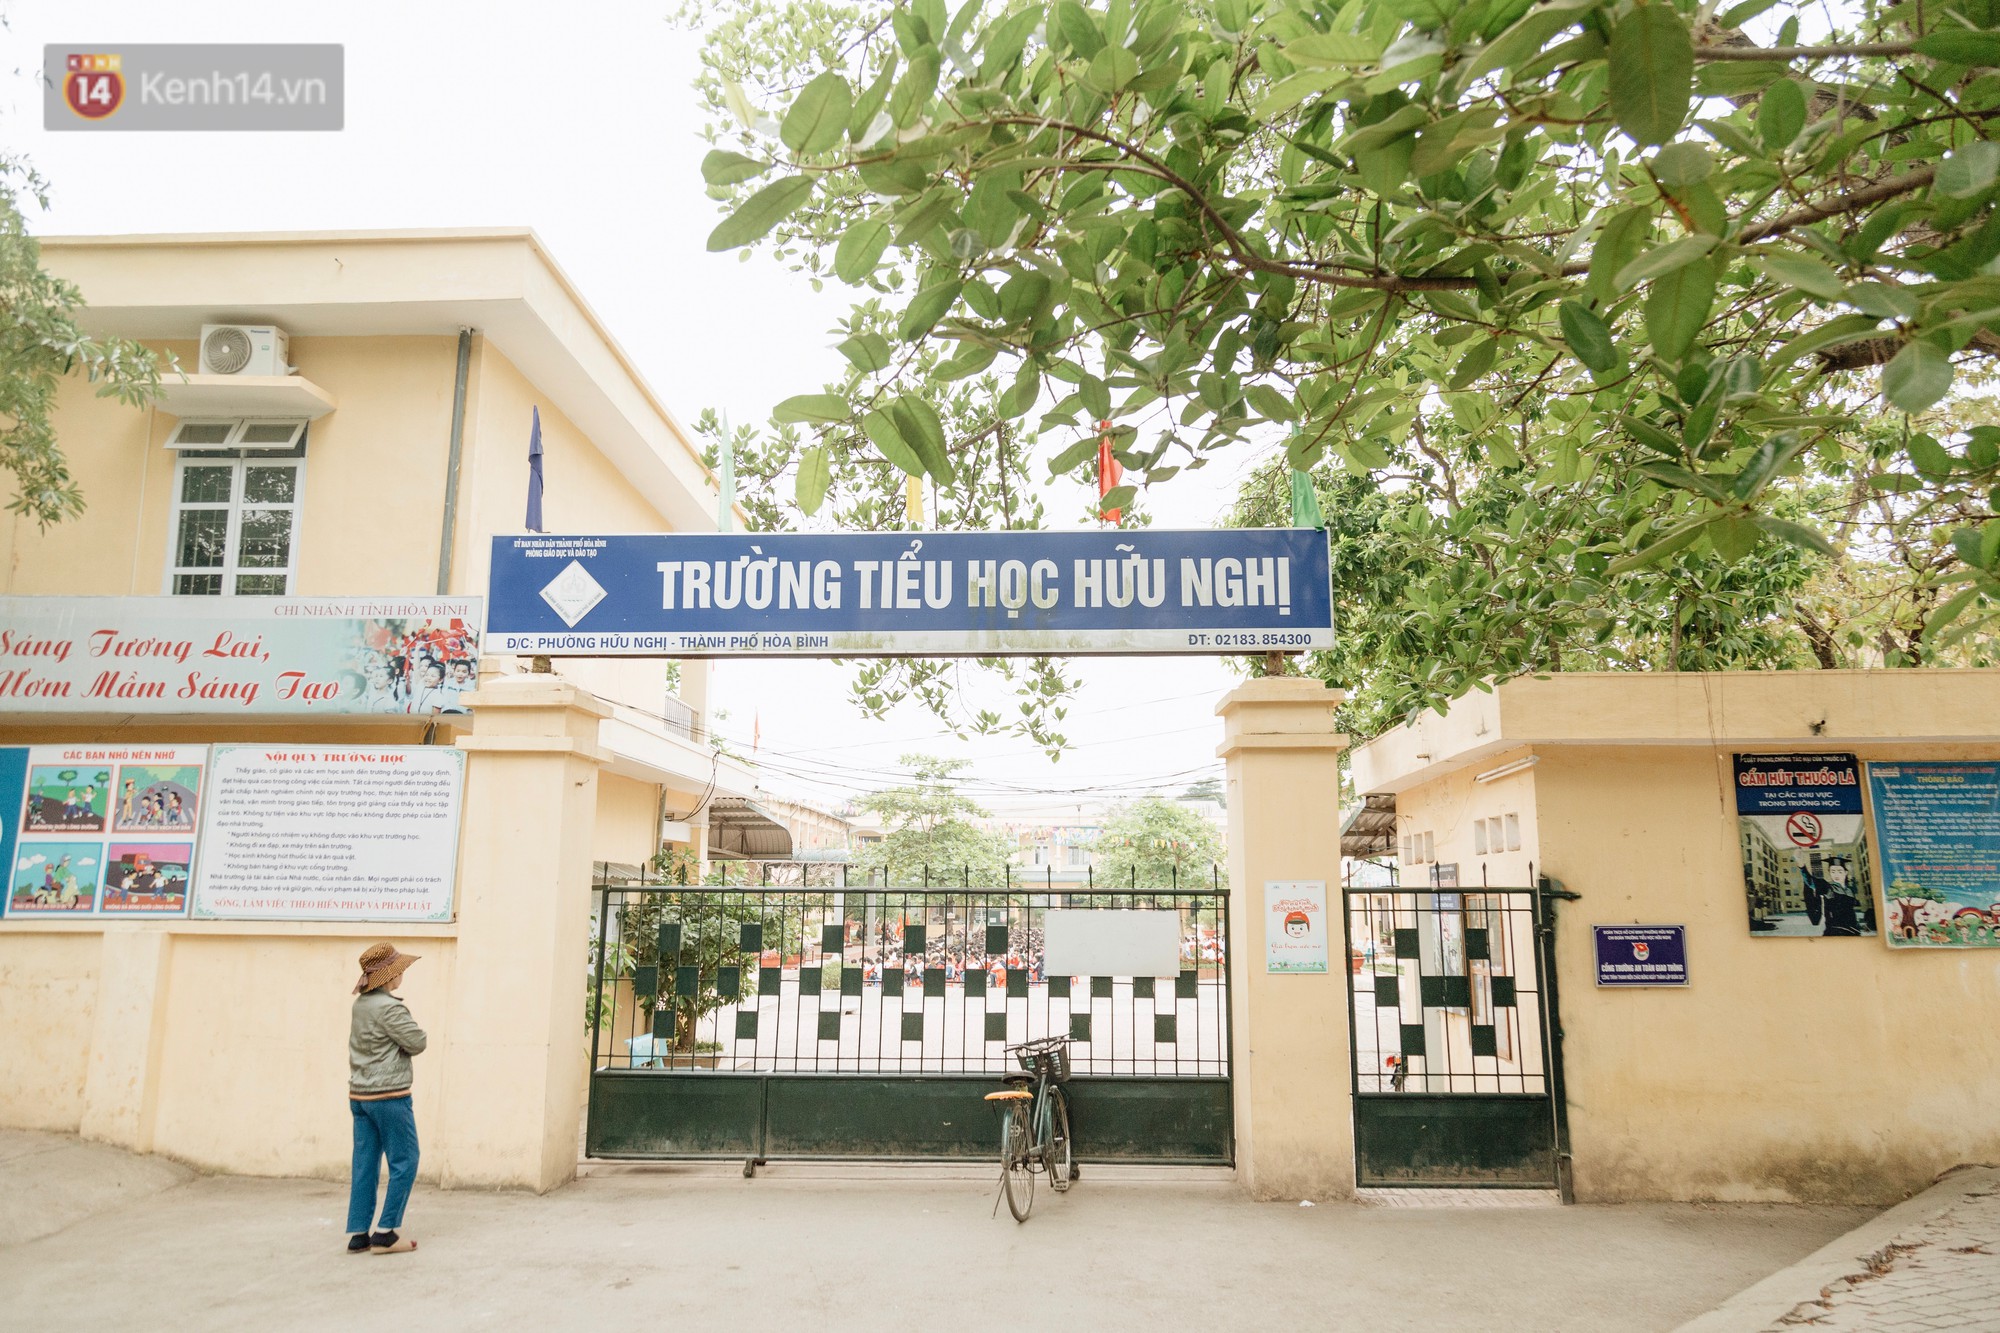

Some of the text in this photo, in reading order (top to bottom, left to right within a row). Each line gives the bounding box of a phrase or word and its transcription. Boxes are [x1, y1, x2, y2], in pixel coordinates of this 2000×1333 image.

[556, 538, 572, 547] THÀNH
[573, 537, 583, 547] PHỐ
[526, 548, 542, 557] PHÒNG
[543, 548, 555, 557] GIÁO
[556, 550, 567, 559] DỤC
[567, 548, 575, 557] VÀ
[587, 549, 597, 558] TẠO
[657, 546, 842, 610] TRƯỜNG
[854, 540, 952, 609] TIỂU
[968, 558, 1059, 619] HỌC
[1074, 544, 1164, 609] HỮU
[1181, 557, 1291, 616] NGHỊ
[274, 605, 298, 616] CHI
[302, 603, 355, 616] NHÁNH
[397, 602, 428, 616] HÒA
[432, 602, 468, 616] BÌNH
[0, 629, 270, 664] Sáng Tương Lai,
[506, 638, 533, 650] Đ/C:
[538, 634, 596, 648] PHƯỜNG
[600, 634, 630, 648] HỮU
[634, 637, 667, 650] NGHỊ
[680, 633, 727, 648] THÀNH
[730, 632, 759, 648] PHỐ
[762, 633, 792, 648] HÒA
[796, 632, 828, 648] BÌNH
[1188, 634, 1312, 647] ĐT: 02183.854300
[80, 671, 165, 698] Mầm
[177, 671, 260, 706] Sáng
[275, 671, 342, 706] Tạo
[64, 748, 176, 761] CÁC BẠN NHỎ NÊN NHỚ
[266, 752, 406, 765] NỘI QUY TRƯỜNG HỌC
[1740, 767, 1767, 786] CẤM
[1769, 768, 1794, 786] HÚT
[1795, 767, 1838, 785] THUỐC
[1839, 768, 1856, 785] LÁ
[1947, 775, 1964, 783] BÁO
[1764, 792, 1776, 800] TẠI
[290, 900, 314, 908] THEO
